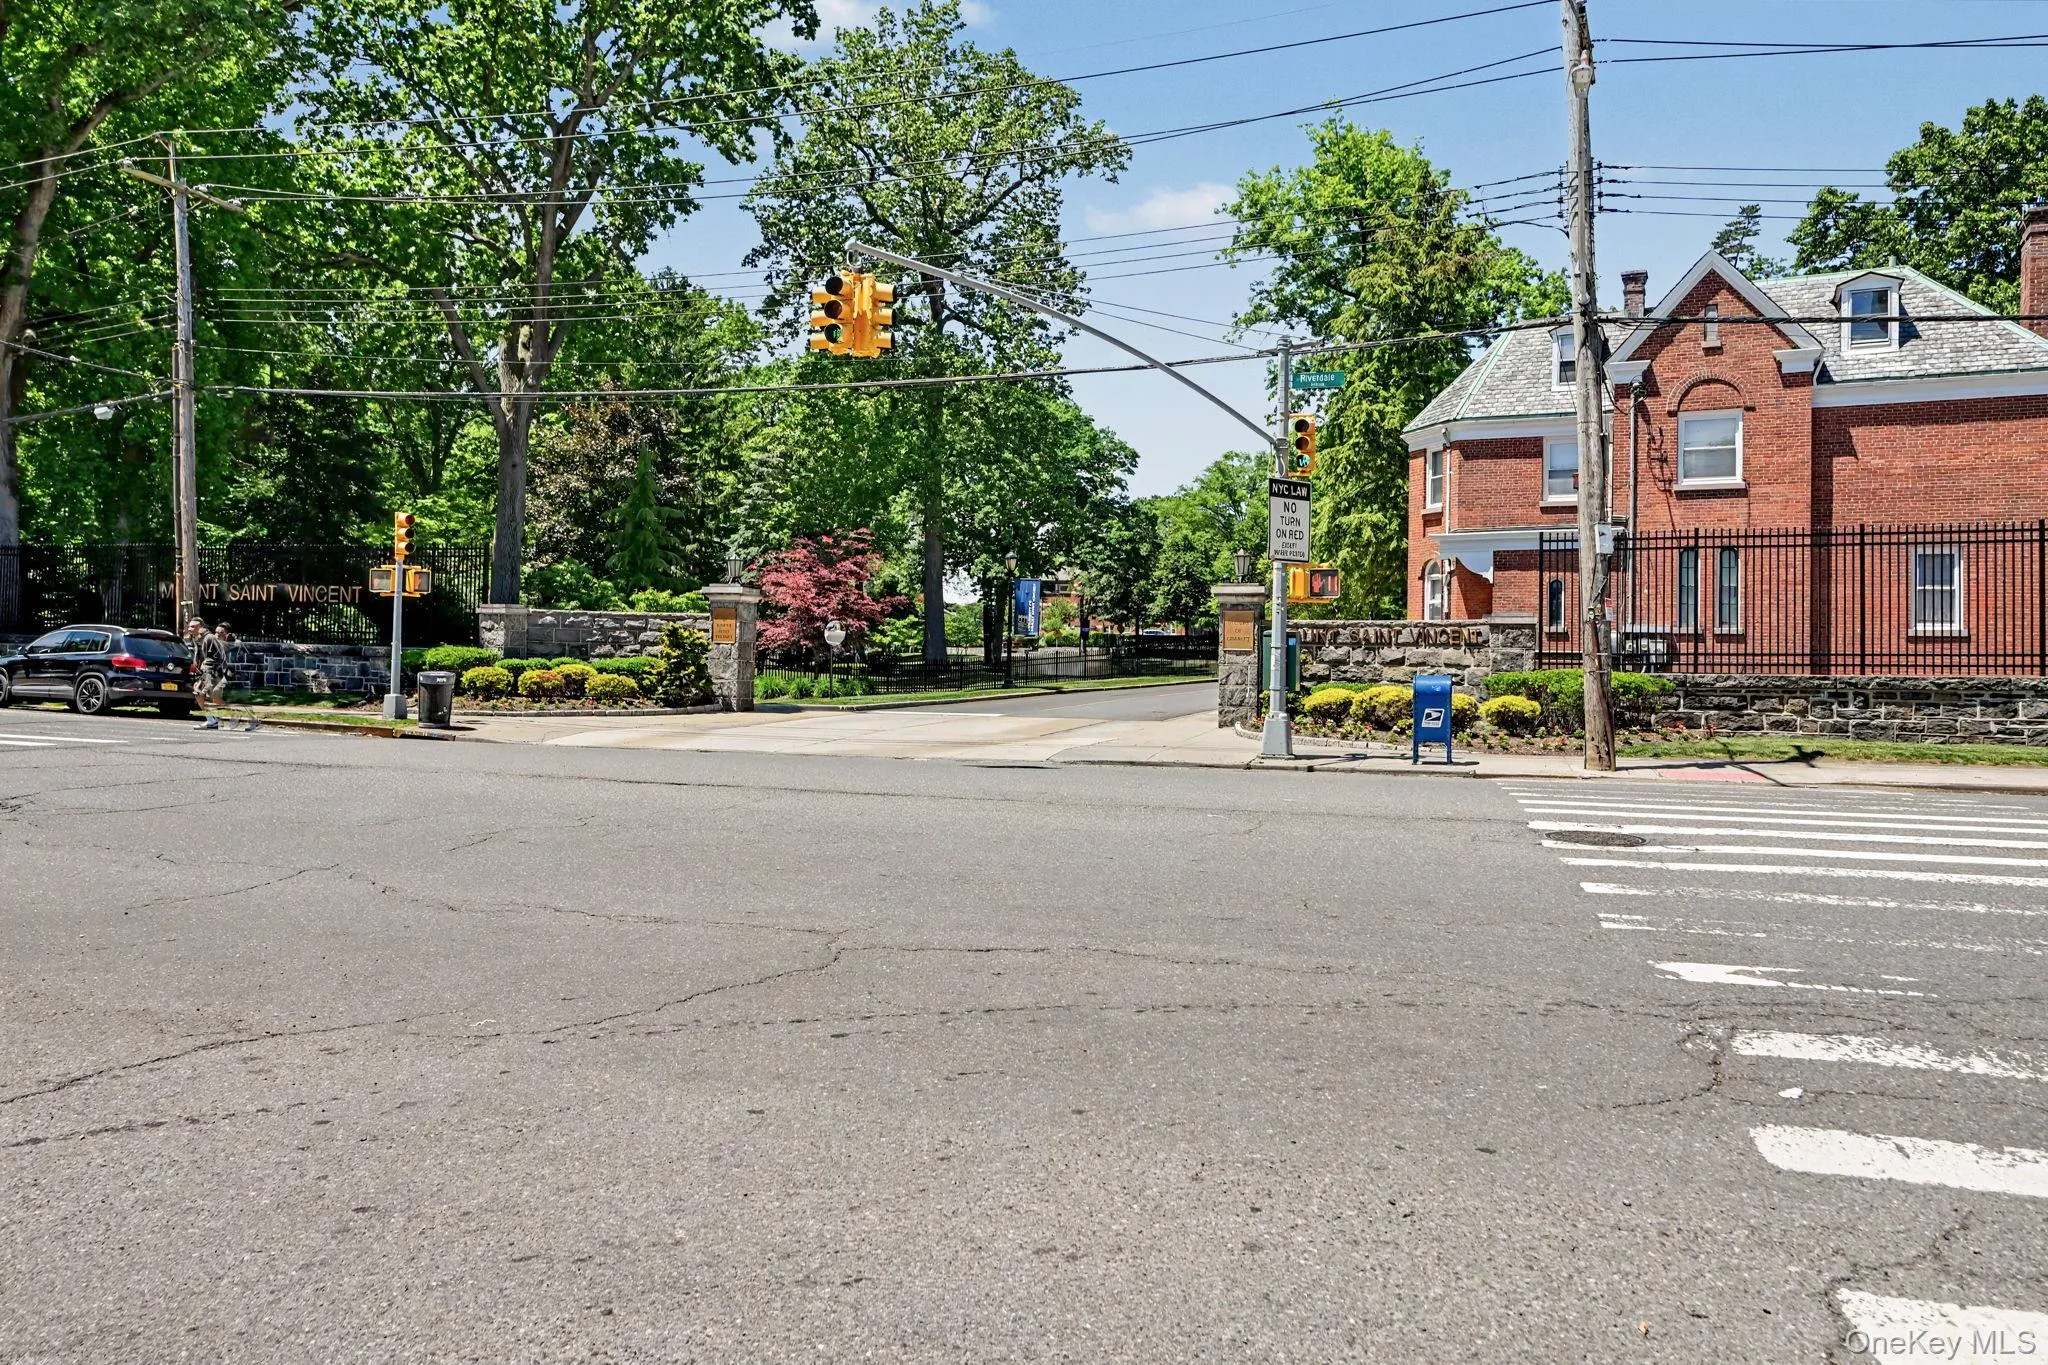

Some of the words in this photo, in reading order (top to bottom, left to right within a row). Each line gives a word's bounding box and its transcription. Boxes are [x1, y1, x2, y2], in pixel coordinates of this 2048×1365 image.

[1300, 373, 1335, 383] Riverdale
[1272, 482, 1289, 495] NYC
[1290, 484, 1308, 498] LAW
[1283, 501, 1297, 514] NO
[1280, 515, 1301, 527] TURN
[1275, 528, 1287, 539] ON
[1288, 529, 1304, 540] RED
[160, 582, 220, 600] MNT
[228, 583, 278, 602] SAINT
[287, 585, 363, 603] VINCENT
[1349, 627, 1403, 645] SAINT
[1409, 627, 1483, 645] VINCENT
